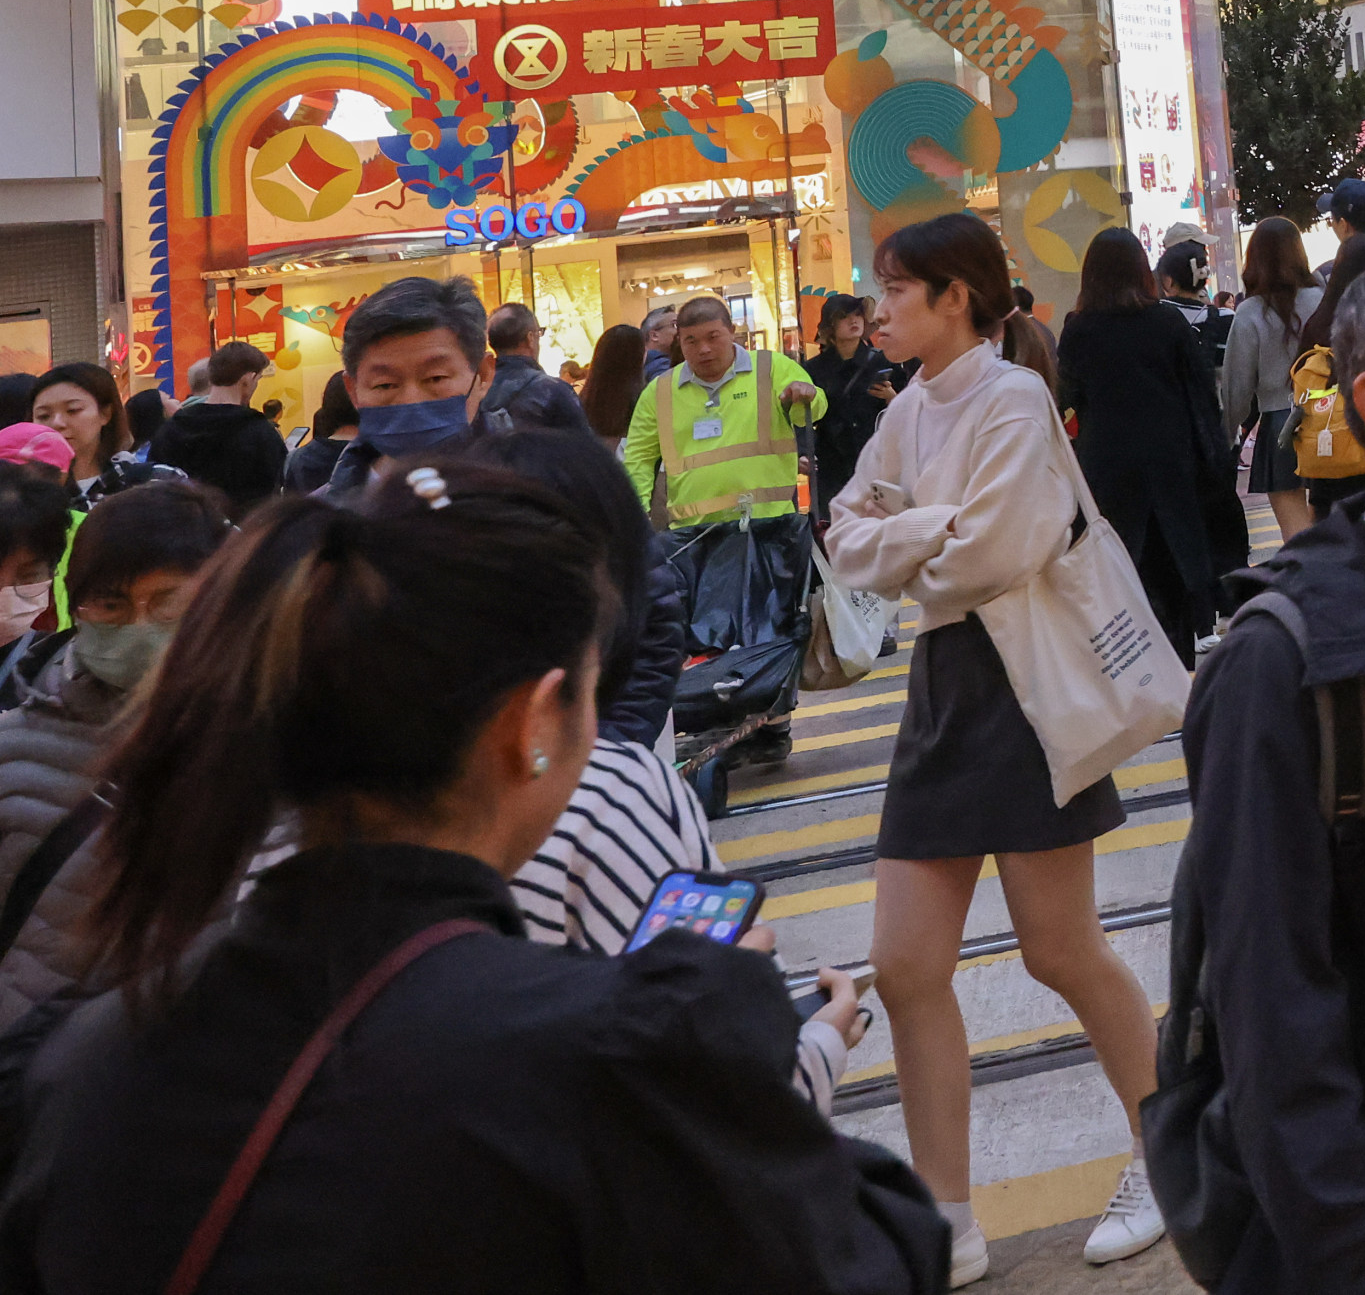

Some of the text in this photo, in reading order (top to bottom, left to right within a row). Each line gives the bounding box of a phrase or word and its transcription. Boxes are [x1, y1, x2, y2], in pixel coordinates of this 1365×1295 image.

[582, 16, 820, 74] 新春大吉
[446, 197, 586, 247] SOGO
